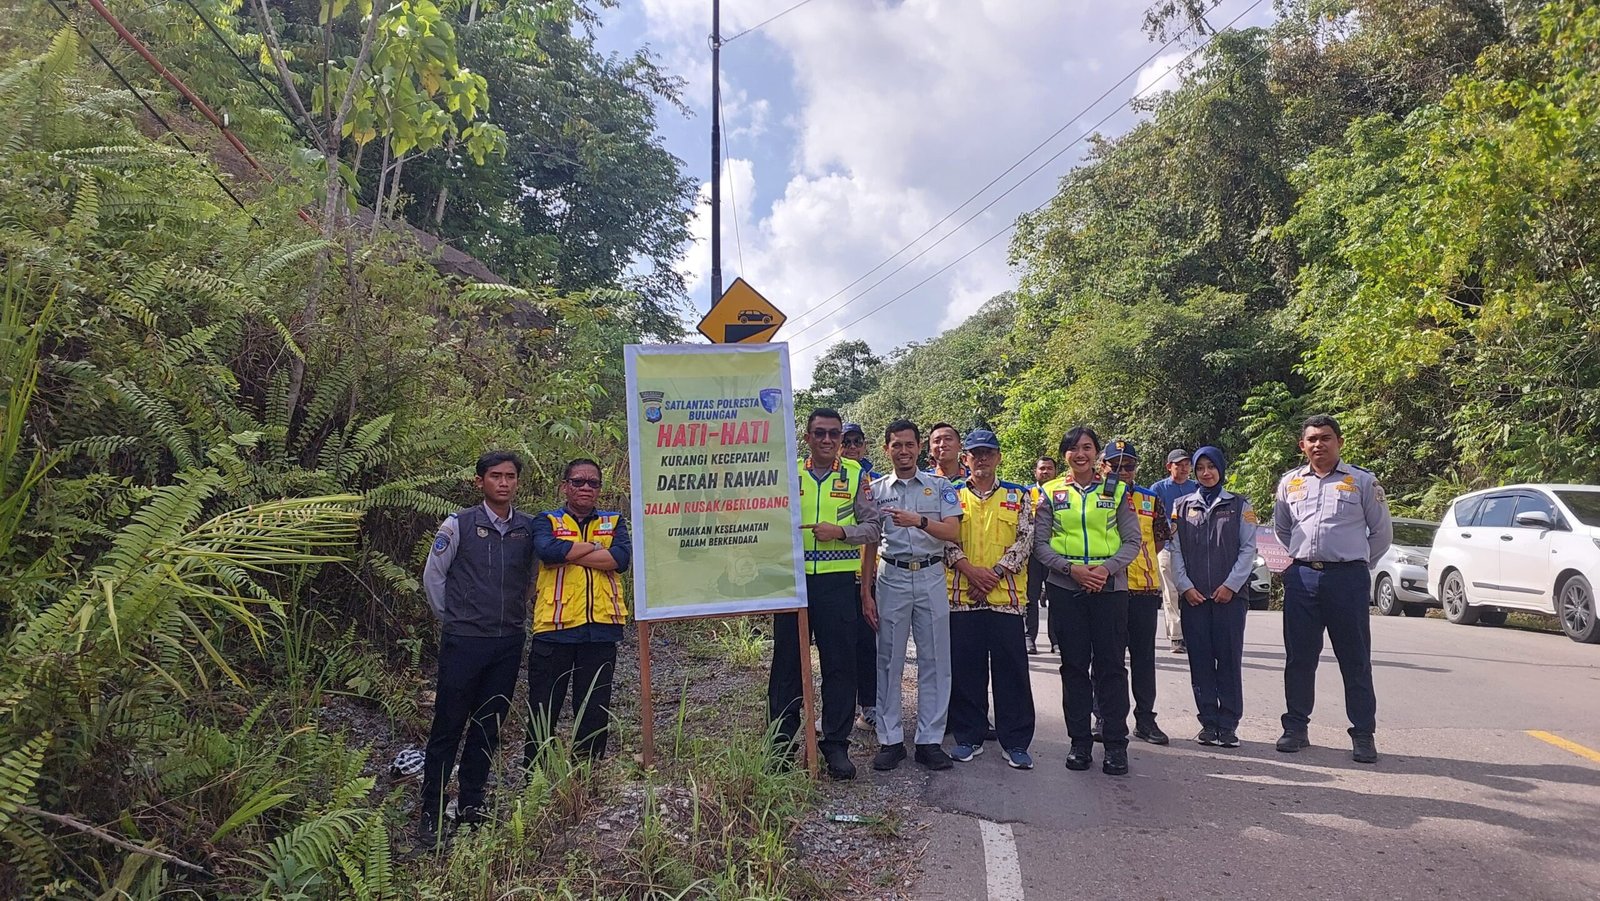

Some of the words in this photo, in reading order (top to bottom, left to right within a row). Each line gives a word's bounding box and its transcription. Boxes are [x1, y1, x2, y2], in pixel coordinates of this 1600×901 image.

[664, 399, 714, 410] SATLANTAS
[717, 398, 760, 409] POLRESTA
[688, 410, 738, 421] BULUNGAN
[656, 420, 770, 448] HATI-HATI
[660, 454, 708, 467] KURANGI
[711, 451, 770, 465] KECEPATAN!
[656, 472, 719, 491] DAERAH
[723, 469, 779, 488] RAWAN
[644, 501, 681, 515] JALAN
[683, 496, 789, 514] RUSAK/BERLOBANG
[667, 524, 712, 537] UTAMAKAN
[714, 522, 769, 535] KESELAMATAN
[679, 537, 706, 548] DALAM
[708, 535, 758, 547] BERKENDARA
